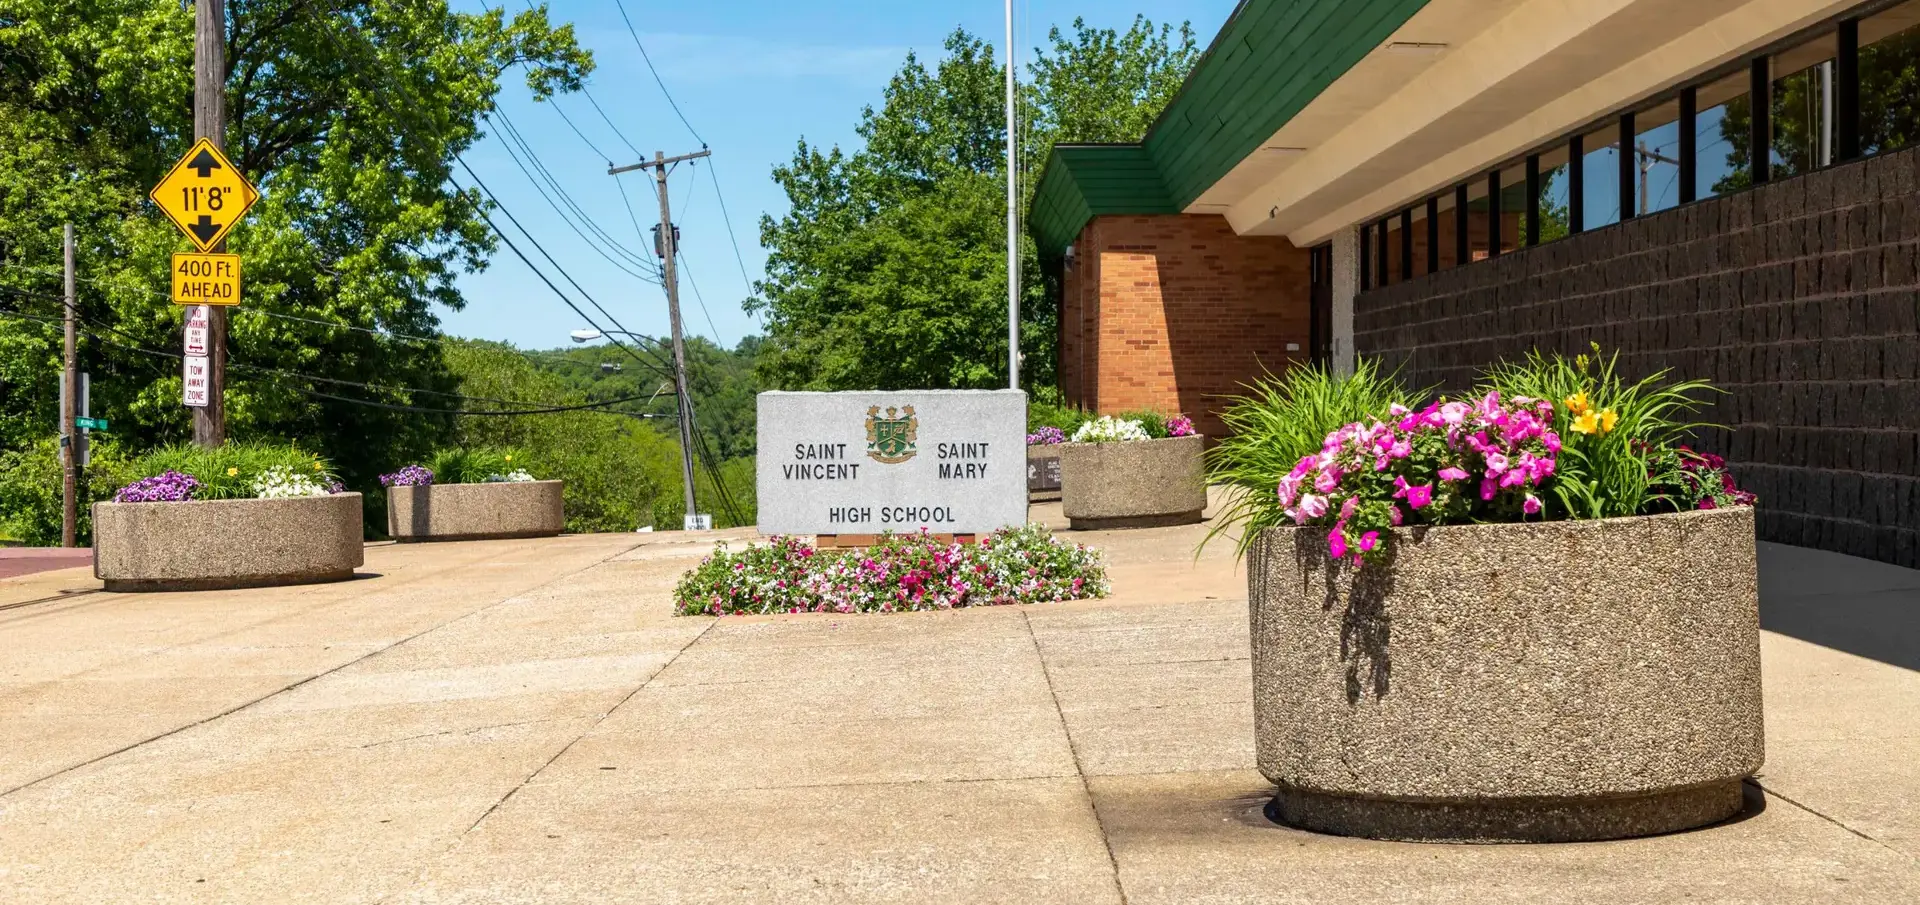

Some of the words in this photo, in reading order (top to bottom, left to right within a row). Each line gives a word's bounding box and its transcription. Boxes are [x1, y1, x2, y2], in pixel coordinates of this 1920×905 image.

[178, 260, 212, 277] 400
[216, 261, 234, 278] Ft.
[181, 282, 232, 298] AHEAD
[191, 308, 201, 318] NO
[186, 319, 207, 329] PARKING
[190, 336, 202, 344] TIME
[190, 366, 203, 375] TOW
[187, 379, 204, 388] AWAY
[187, 391, 204, 400] ZONE
[795, 443, 847, 460] SAINT
[937, 442, 989, 459] SAINT
[783, 463, 860, 480] VINCENT
[938, 463, 988, 479] MARY
[829, 507, 871, 523] HIGH
[881, 506, 955, 523] SCHOOL
